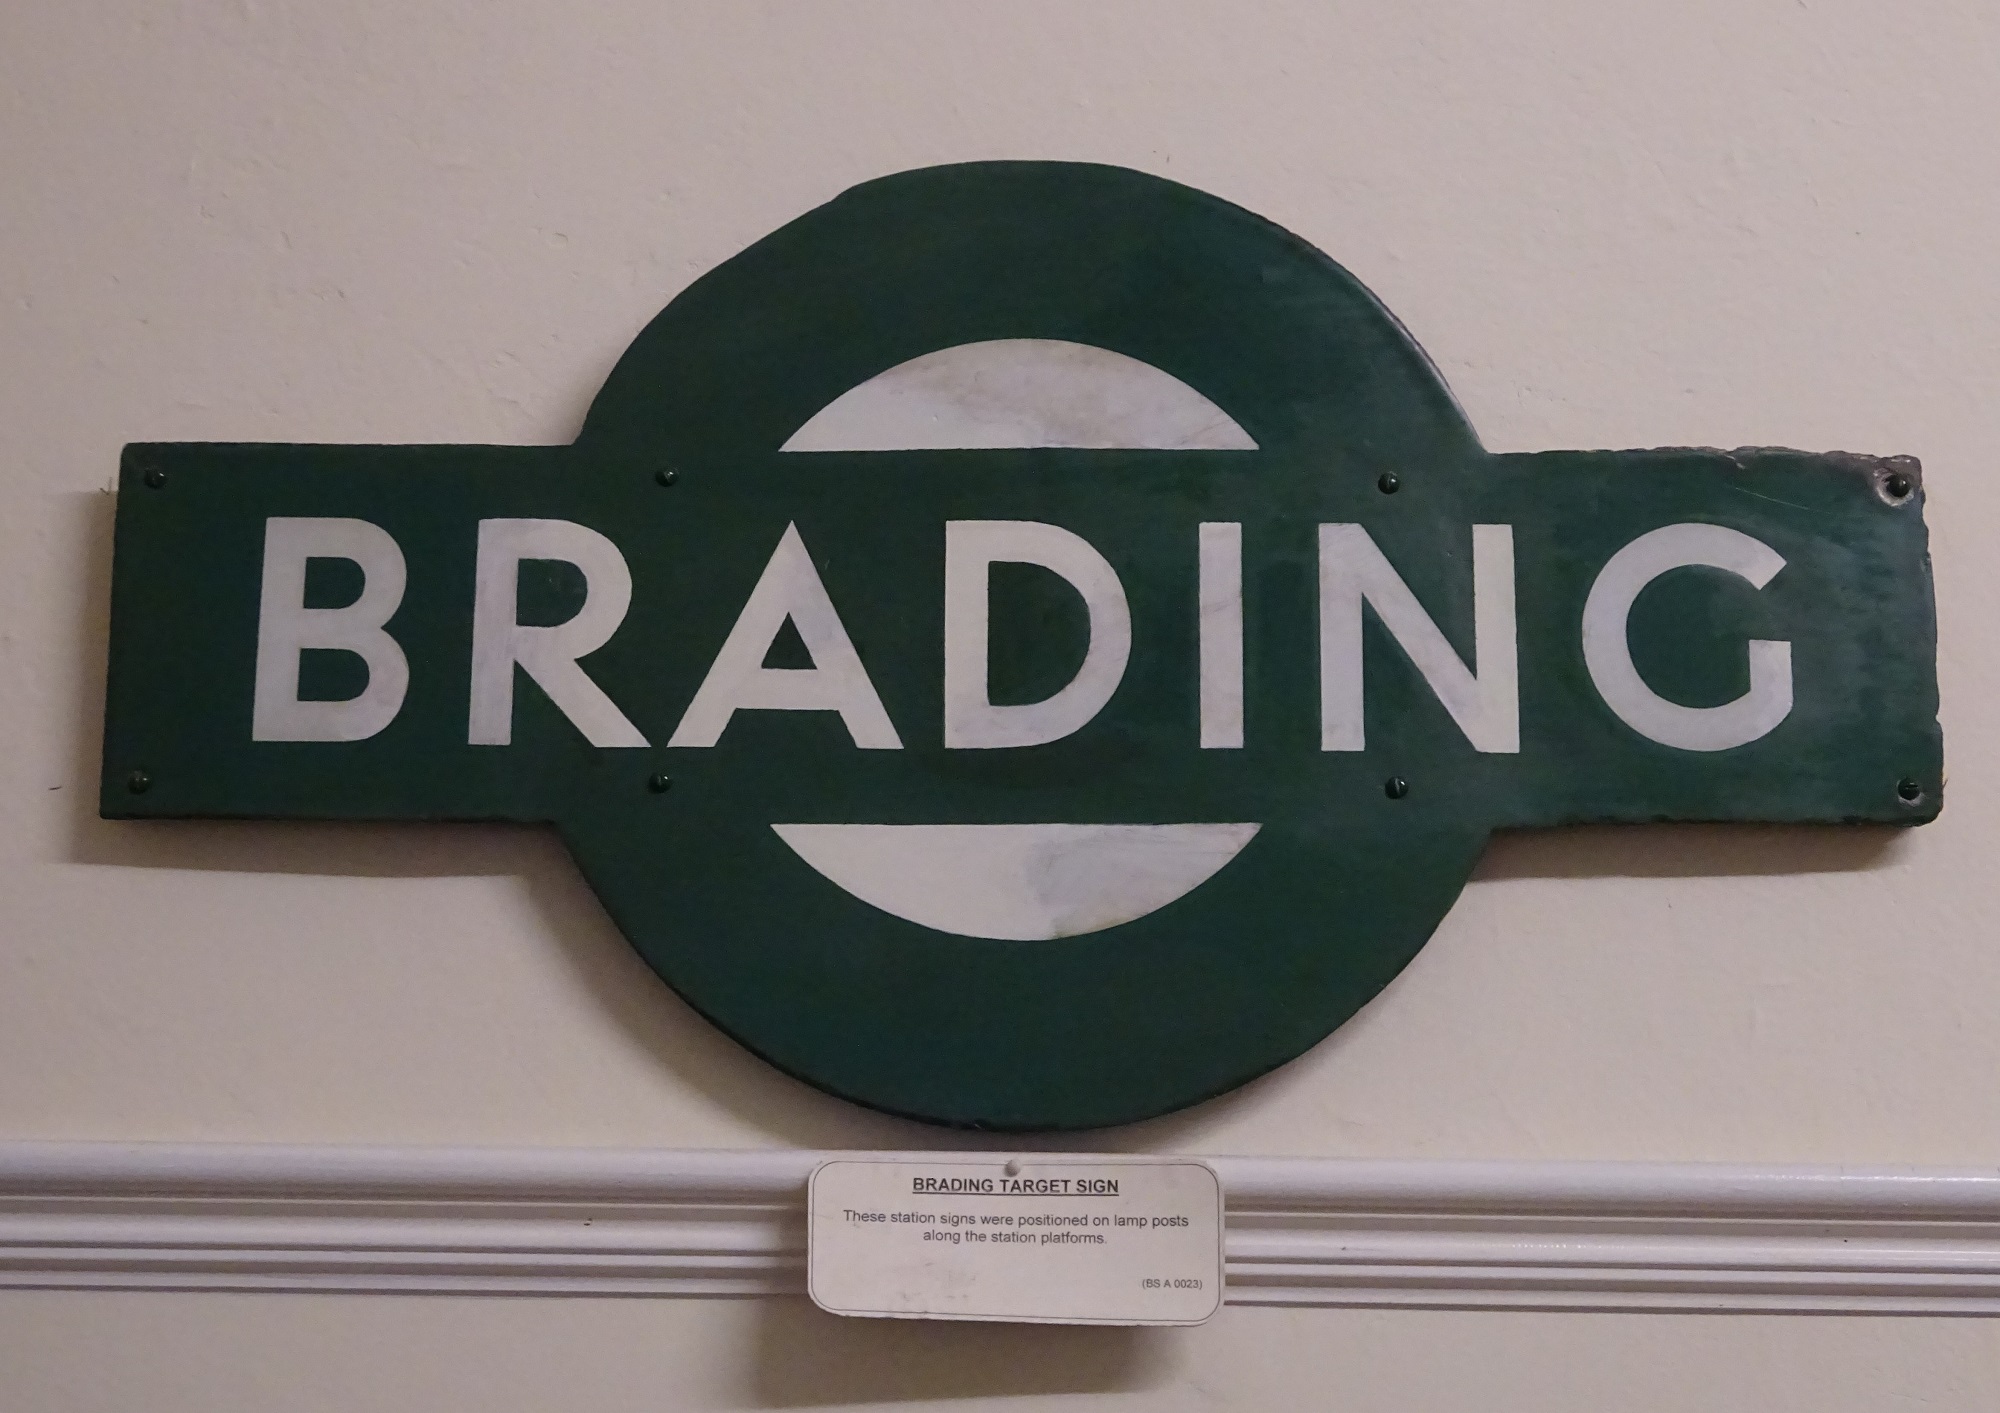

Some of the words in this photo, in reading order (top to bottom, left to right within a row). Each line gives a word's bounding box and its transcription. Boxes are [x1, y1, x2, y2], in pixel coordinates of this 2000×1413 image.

[252, 517, 1794, 754] BRADING
[912, 1177, 993, 1193] BRADING
[1000, 1178, 1071, 1194] TARGET
[1076, 1179, 1119, 1194] SIGN
[843, 1209, 886, 1223] These
[890, 1211, 935, 1225] station
[940, 1212, 976, 1228] signs
[980, 1215, 1014, 1226] were
[1018, 1213, 1088, 1229] positioned
[1092, 1216, 1110, 1227] on
[1114, 1214, 1148, 1230] lamp
[1152, 1215, 1189, 1231] posts
[923, 1229, 961, 1245] along
[964, 1230, 987, 1243] the
[991, 1231, 1036, 1244] station
[1040, 1232, 1107, 1246] platforms.
[1142, 1278, 1161, 1290] (BS
[1163, 1279, 1173, 1289] A
[1174, 1279, 1203, 1290] 0023)
